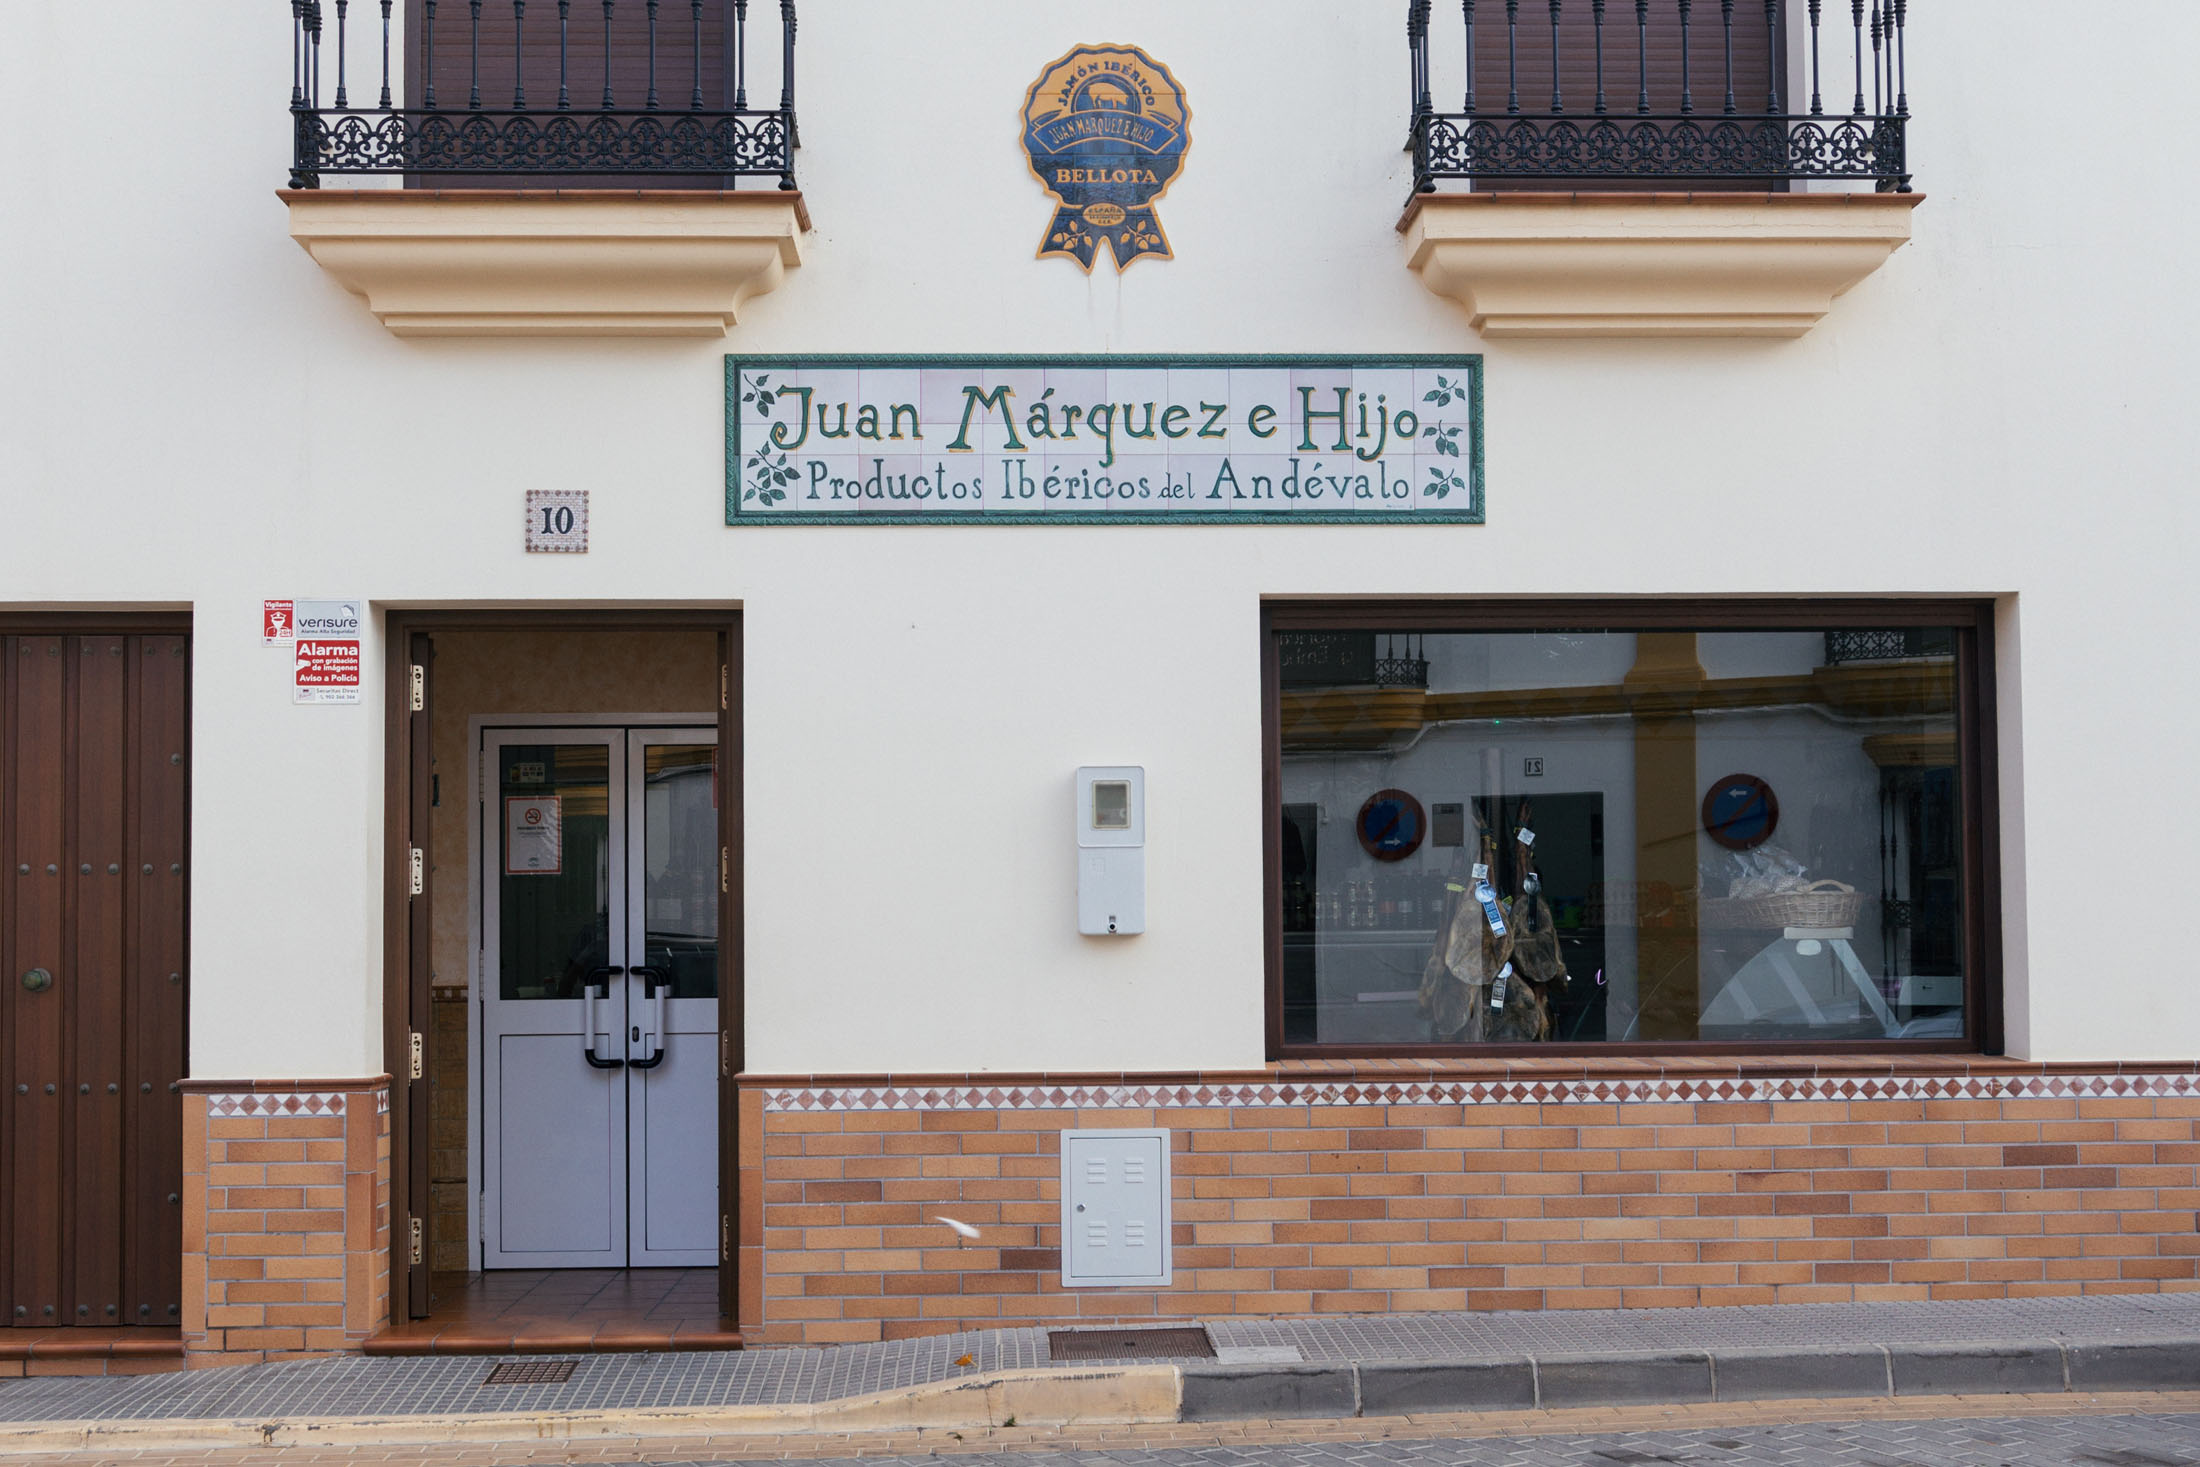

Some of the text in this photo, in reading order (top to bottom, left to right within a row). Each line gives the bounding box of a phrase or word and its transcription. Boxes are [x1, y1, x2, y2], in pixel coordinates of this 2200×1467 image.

[1058, 61, 1155, 107] JAMÓN IBÉRICO
[1049, 121, 1076, 144] JUAN
[1123, 120, 1132, 136] E
[1131, 122, 1154, 143] HIJO
[1056, 168, 1158, 184] BELLOTA
[770, 384, 1420, 468] Juan Márquez e Hijo
[806, 457, 1411, 500] Productos Ibéricos del Andévalo
[541, 506, 574, 534] 10
[298, 618, 358, 628] verisure
[298, 642, 358, 656] Alarma
[323, 664, 358, 673] imágenes
[325, 657, 358, 665] grabación
[299, 674, 322, 682] Aviso
[331, 673, 358, 682] Policía
